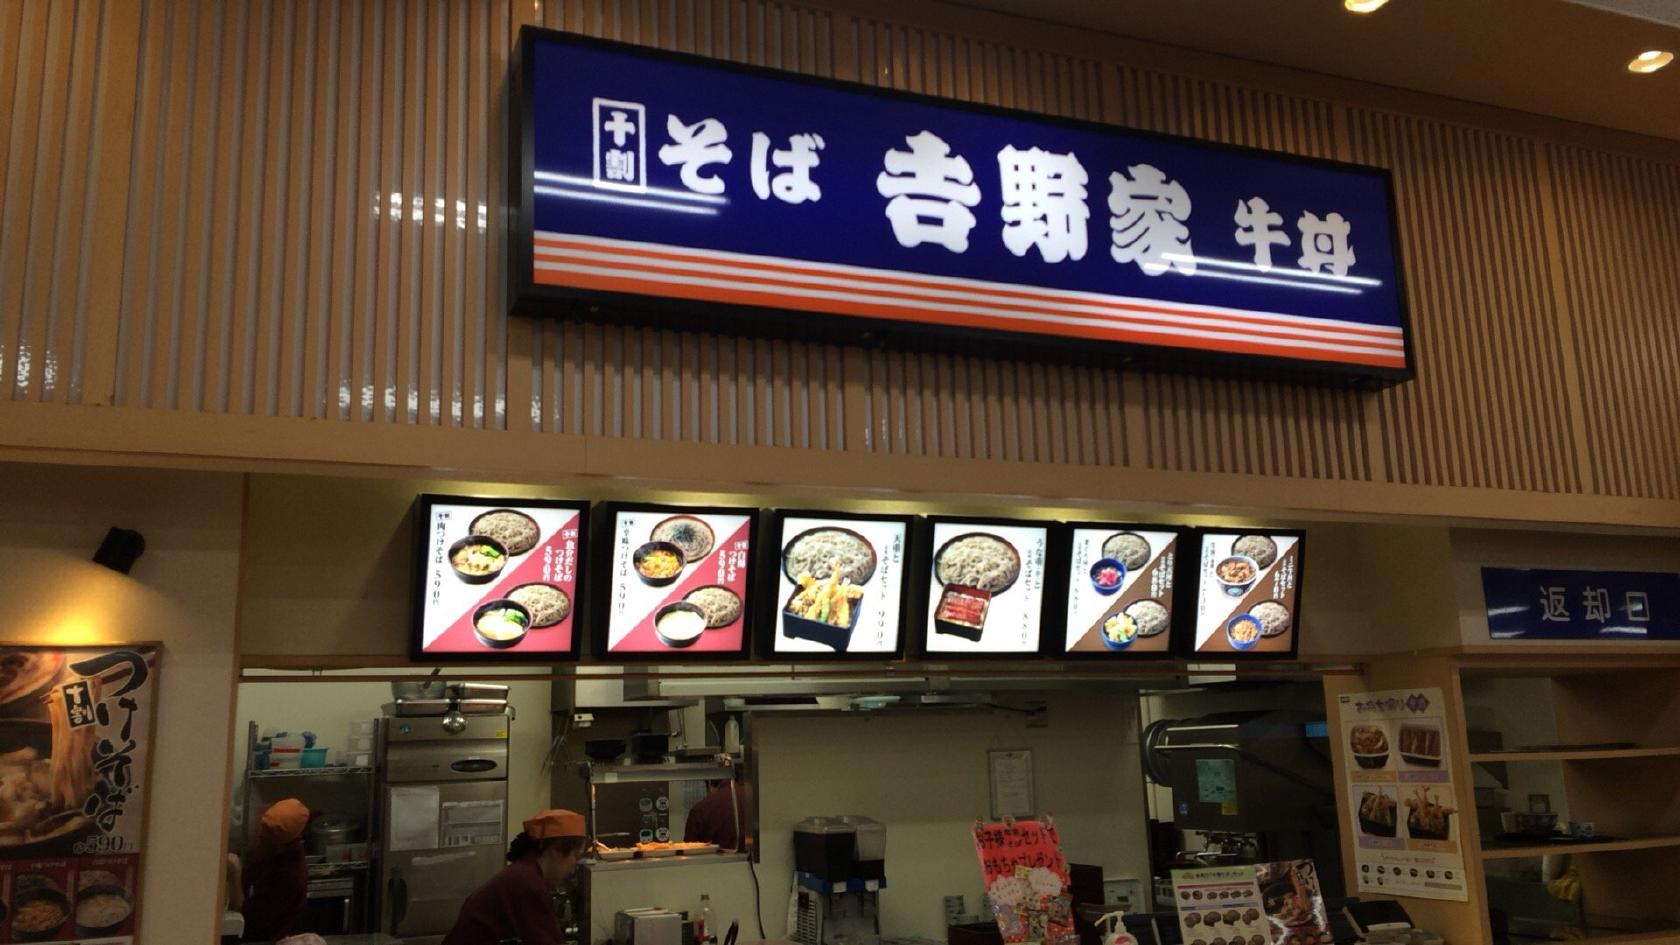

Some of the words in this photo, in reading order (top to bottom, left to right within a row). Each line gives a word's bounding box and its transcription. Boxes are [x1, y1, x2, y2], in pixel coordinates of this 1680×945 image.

[603, 110, 636, 182] 十割
[658, 113, 826, 204] そば
[1234, 196, 1357, 277] 牛丼
[1539, 585, 1650, 623] 返却口
[66, 684, 93, 724] 十割
[69, 651, 149, 832] つけそば
